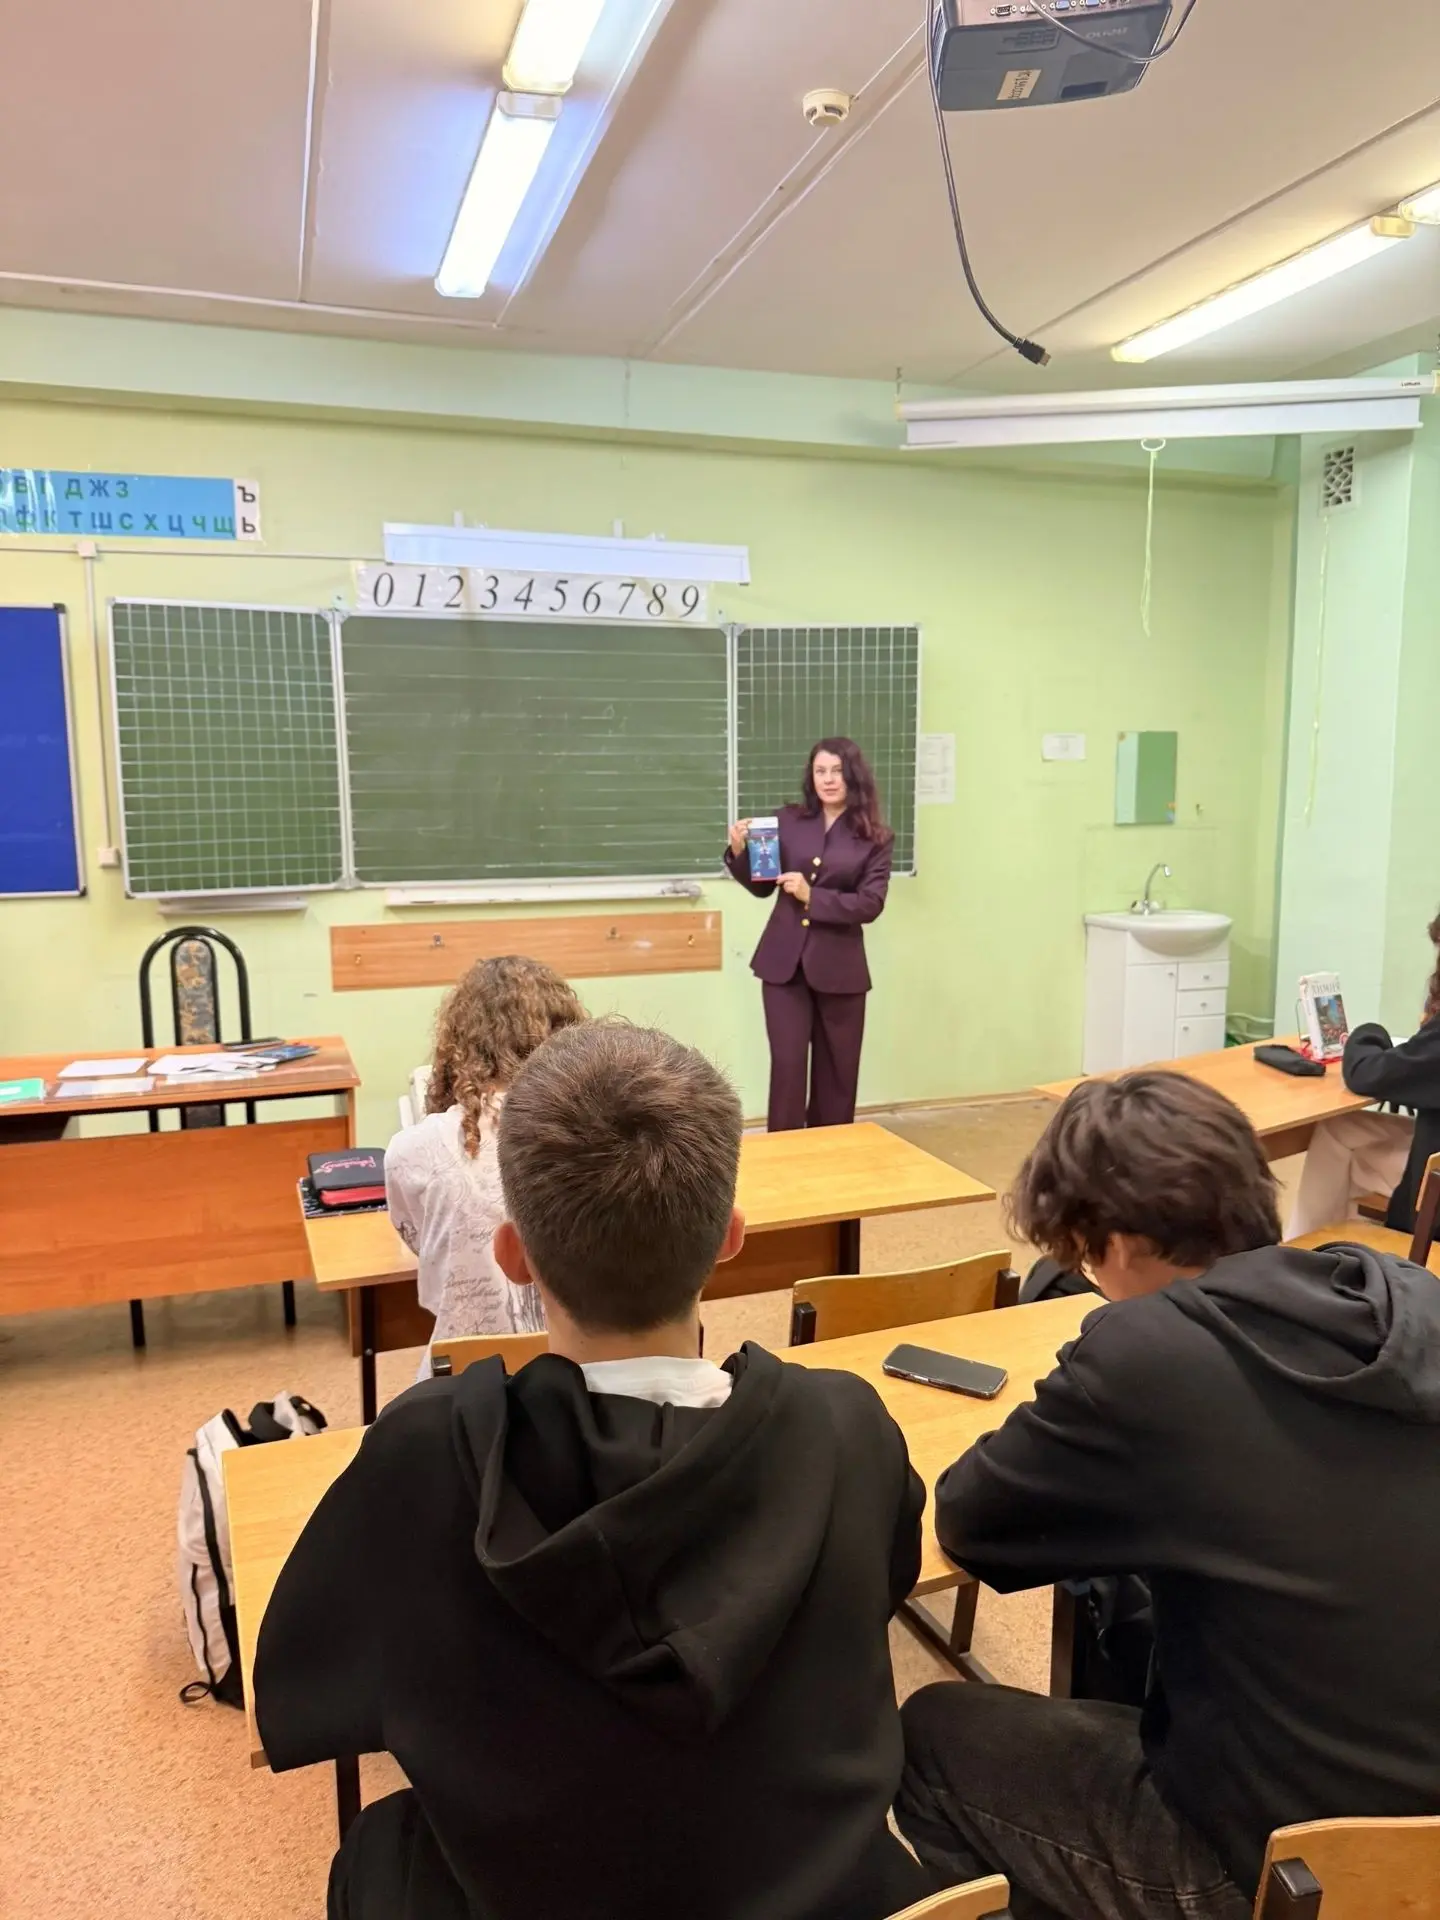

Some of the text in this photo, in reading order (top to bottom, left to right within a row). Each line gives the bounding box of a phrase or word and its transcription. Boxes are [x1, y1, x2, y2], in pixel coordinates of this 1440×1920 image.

[64, 477, 84, 500] Д
[89, 478, 110, 498] Ж
[115, 480, 129, 498] З
[237, 485, 256, 503] Ъ
[68, 511, 82, 529] Т
[91, 512, 112, 530] Ш
[119, 513, 134, 531] С
[143, 513, 159, 531] Х
[168, 515, 185, 536] Ц
[192, 515, 206, 532] Ч
[213, 517, 236, 538] Щ
[242, 516, 256, 533] Ь
[373, 573, 700, 618] 0 1 2 3 4 5 6 7 8 9
